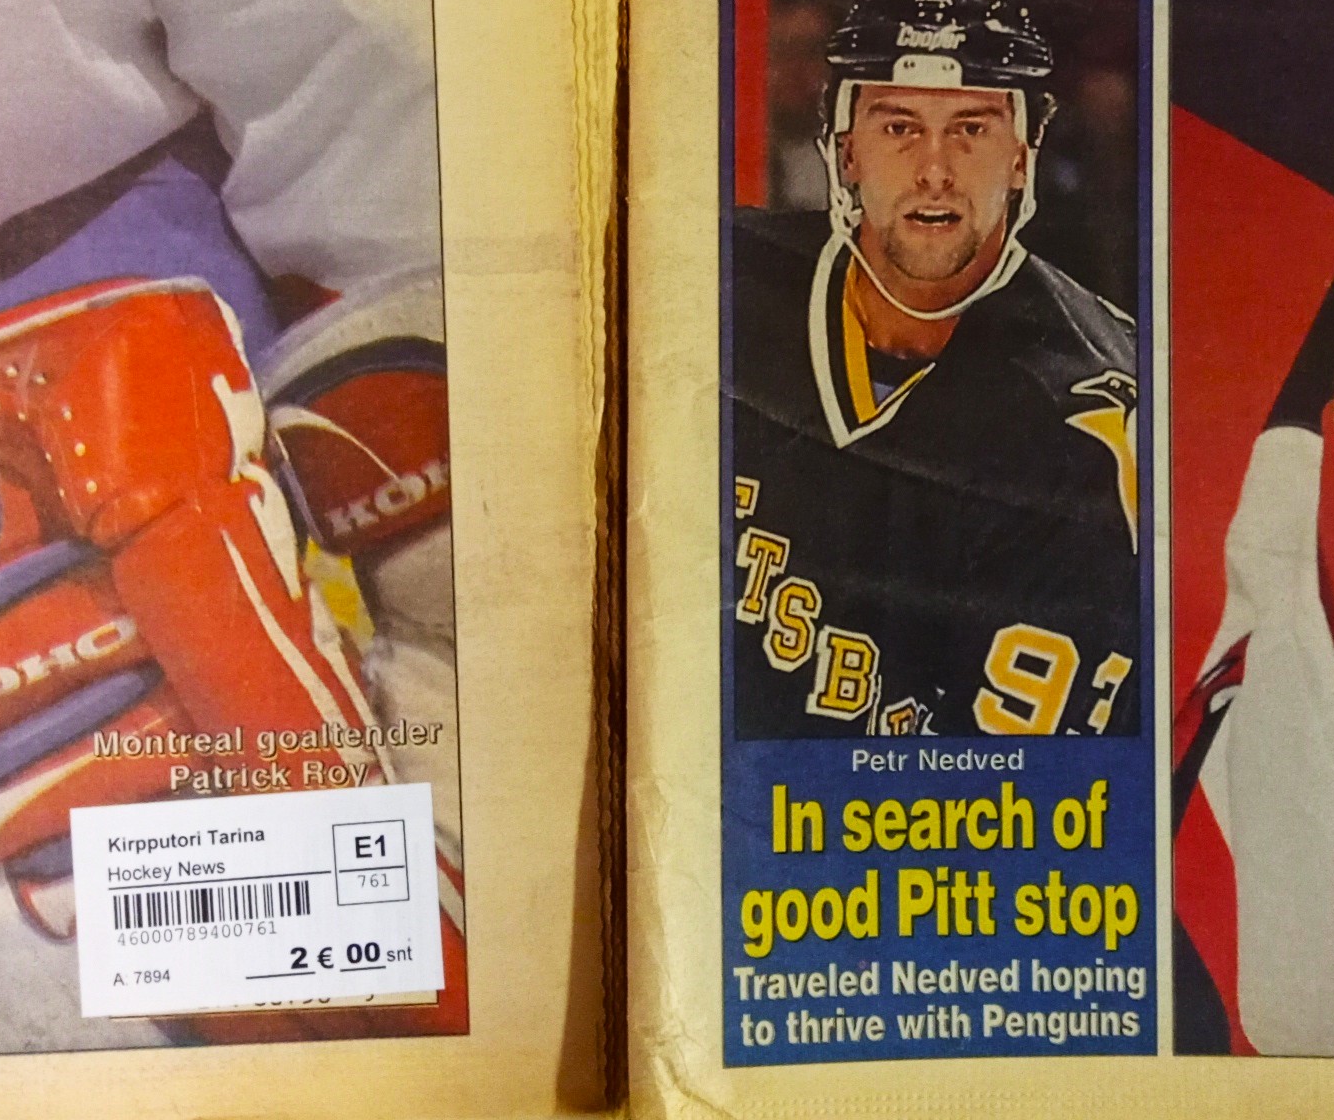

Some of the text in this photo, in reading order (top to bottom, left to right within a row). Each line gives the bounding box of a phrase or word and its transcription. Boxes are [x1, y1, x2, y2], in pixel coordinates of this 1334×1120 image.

[93, 720, 444, 760] Montreal goaltender
[852, 747, 1025, 772] Petr Nedved
[169, 760, 368, 792] Patrick Roy
[771, 779, 1109, 854] In search of
[108, 828, 266, 857] Kirpputori Tarina
[354, 835, 388, 859] E1
[108, 860, 226, 884] Hockey News
[358, 872, 390, 890] 761
[740, 866, 1140, 959] good Pitt stop
[117, 920, 277, 947] 46000789400761
[290, 941, 413, 970] 2 € 00 snt
[133, 969, 171, 985] 7894
[733, 958, 1147, 1001] Traveled Nedved hoping
[741, 1002, 1141, 1047] to thrive with Penguins
